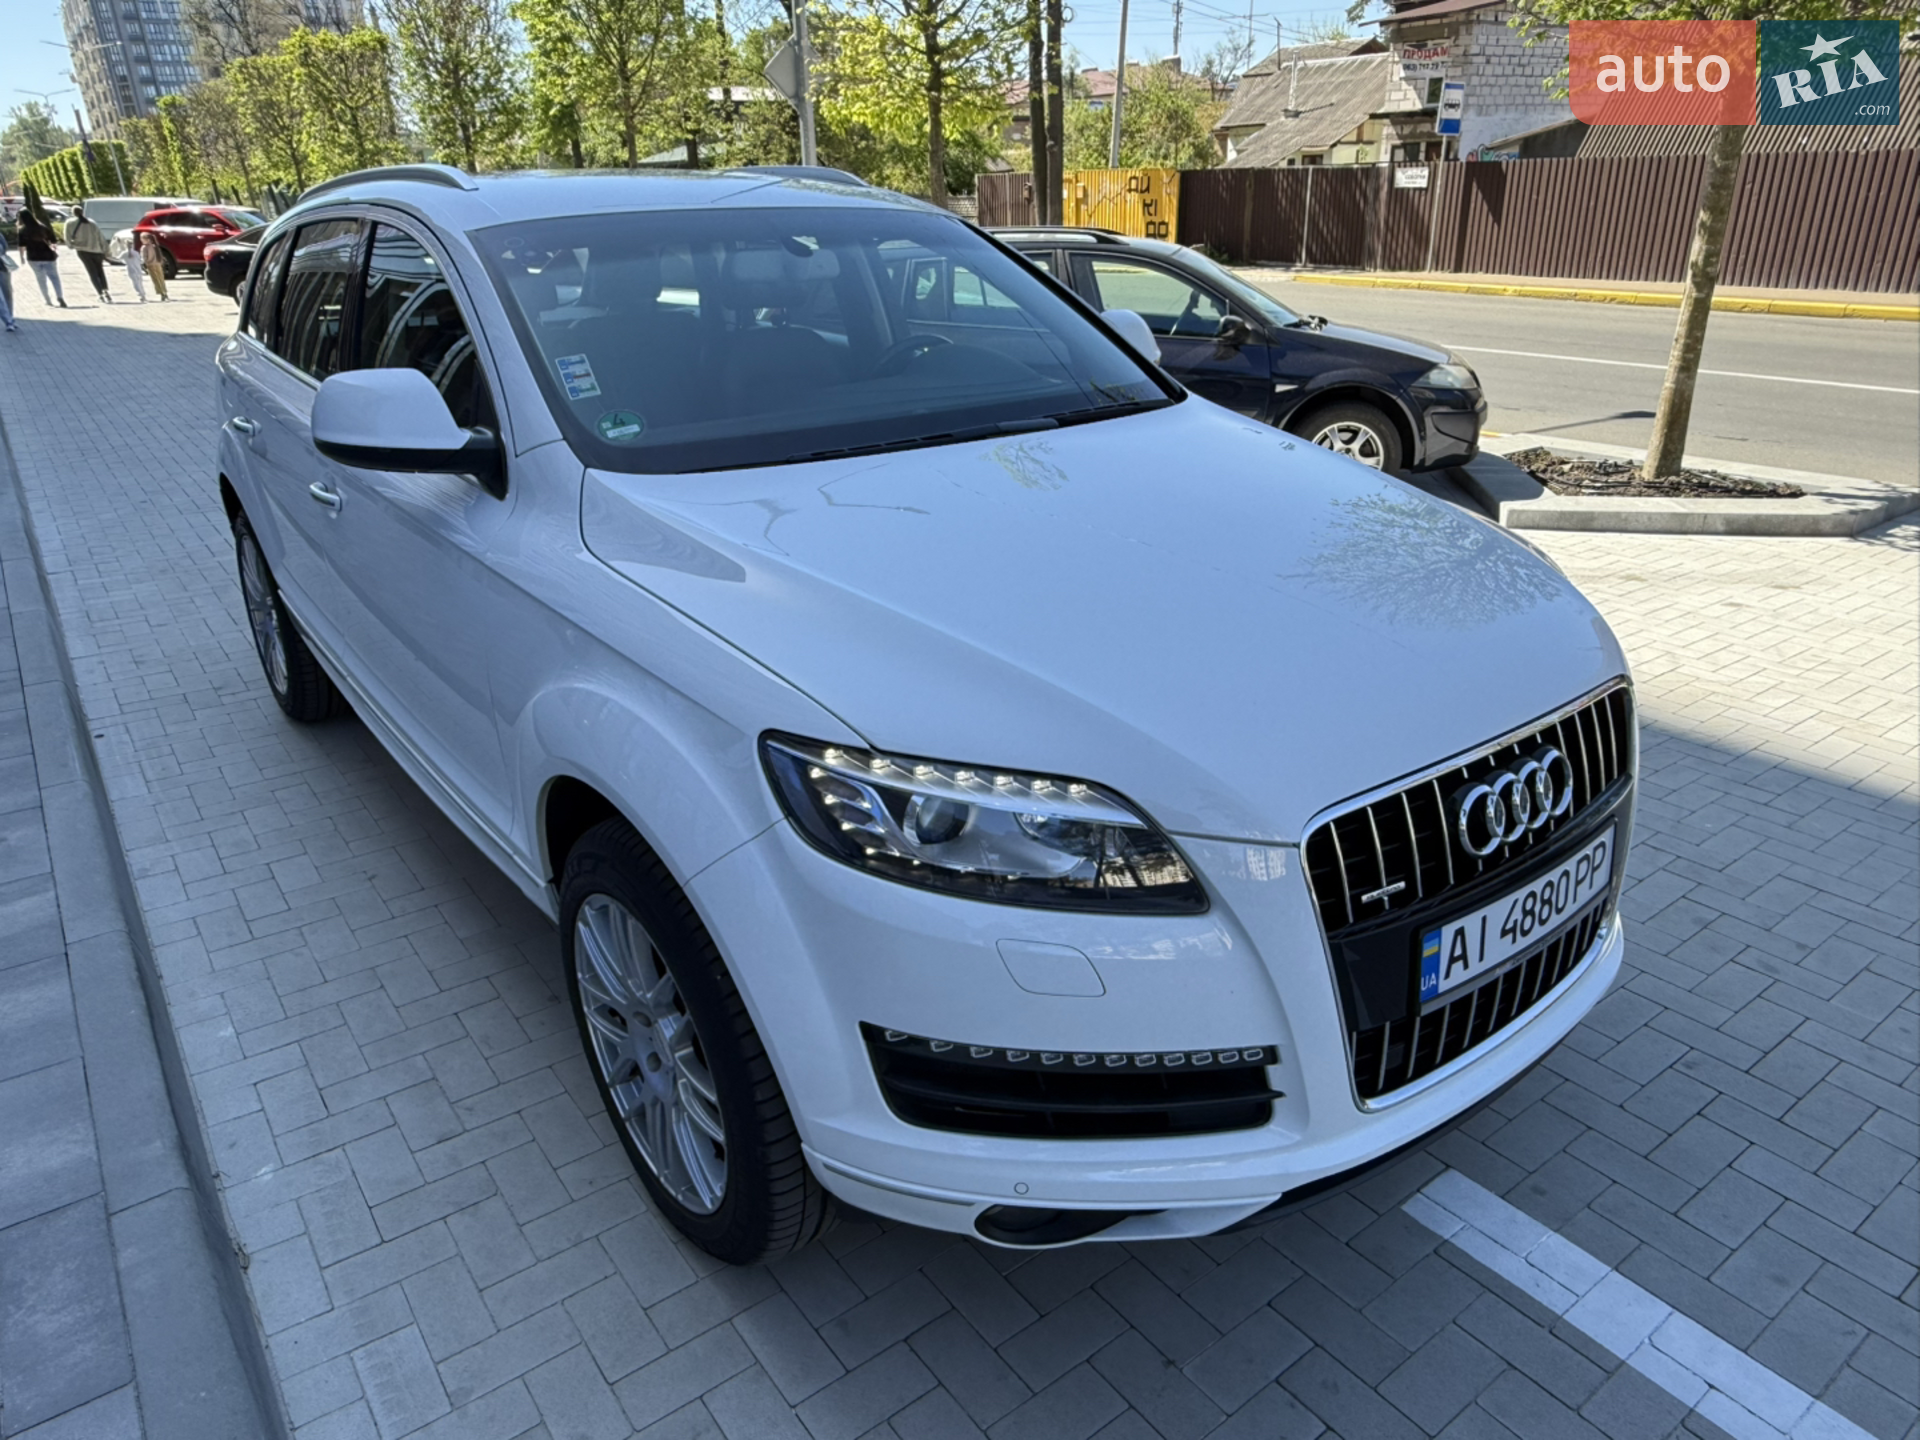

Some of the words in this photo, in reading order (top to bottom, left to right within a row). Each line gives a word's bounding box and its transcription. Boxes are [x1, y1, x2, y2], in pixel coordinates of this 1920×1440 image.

[1444, 914, 1487, 981] AI
[1500, 868, 1570, 945] 4880
[1572, 840, 1607, 905] PP
[1420, 972, 1437, 991] UA
